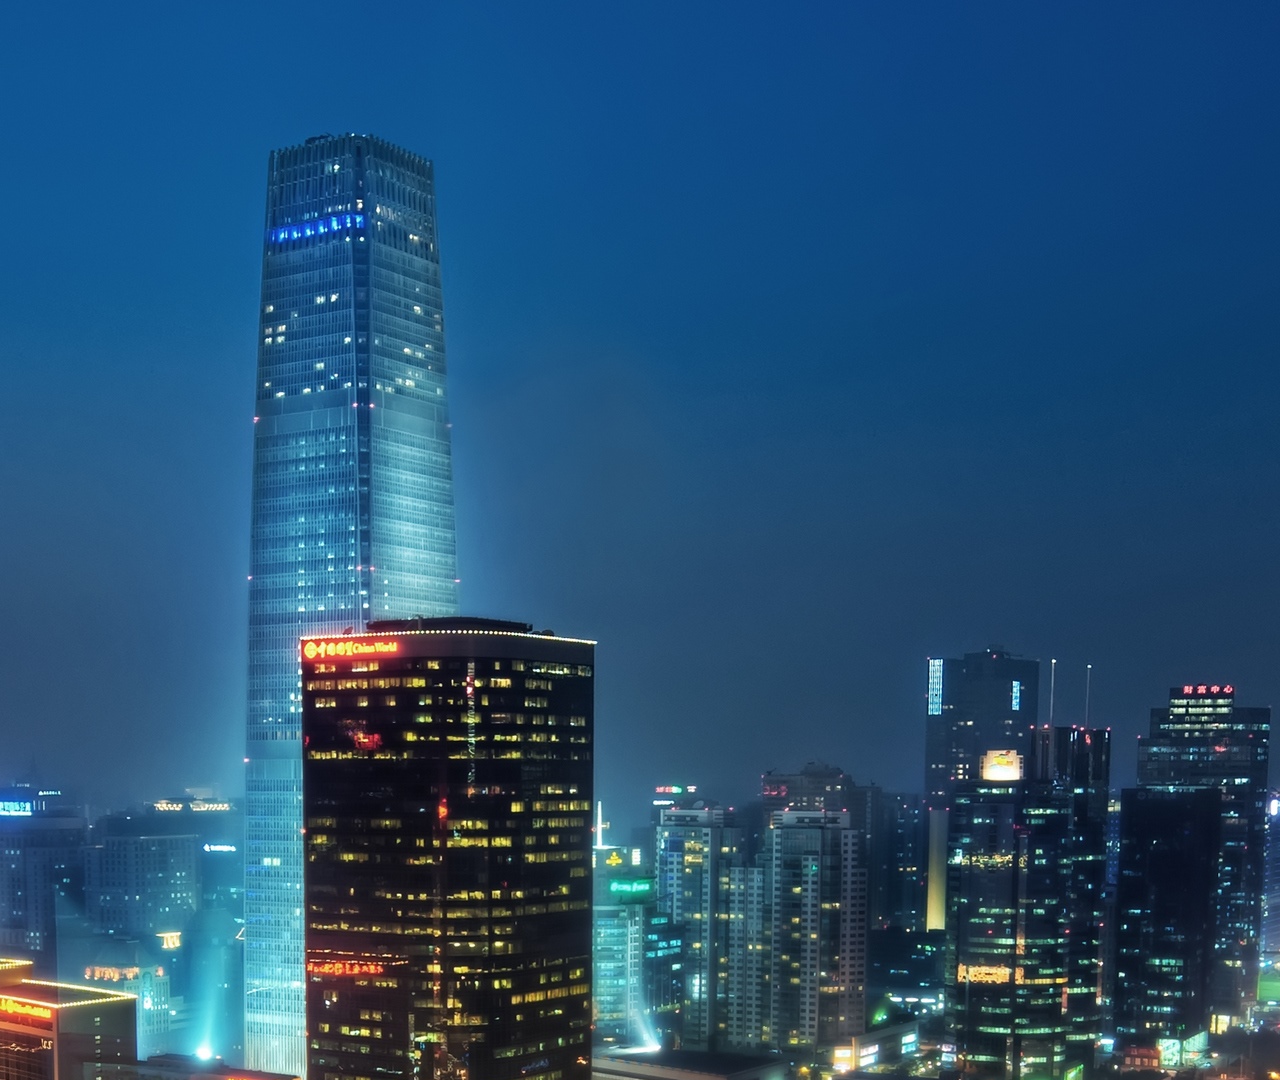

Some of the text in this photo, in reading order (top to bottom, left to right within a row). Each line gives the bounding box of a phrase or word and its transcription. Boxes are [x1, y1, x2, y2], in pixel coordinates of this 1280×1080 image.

[353, 641, 398, 654] China World
[1183, 684, 1233, 695] 财富中心
